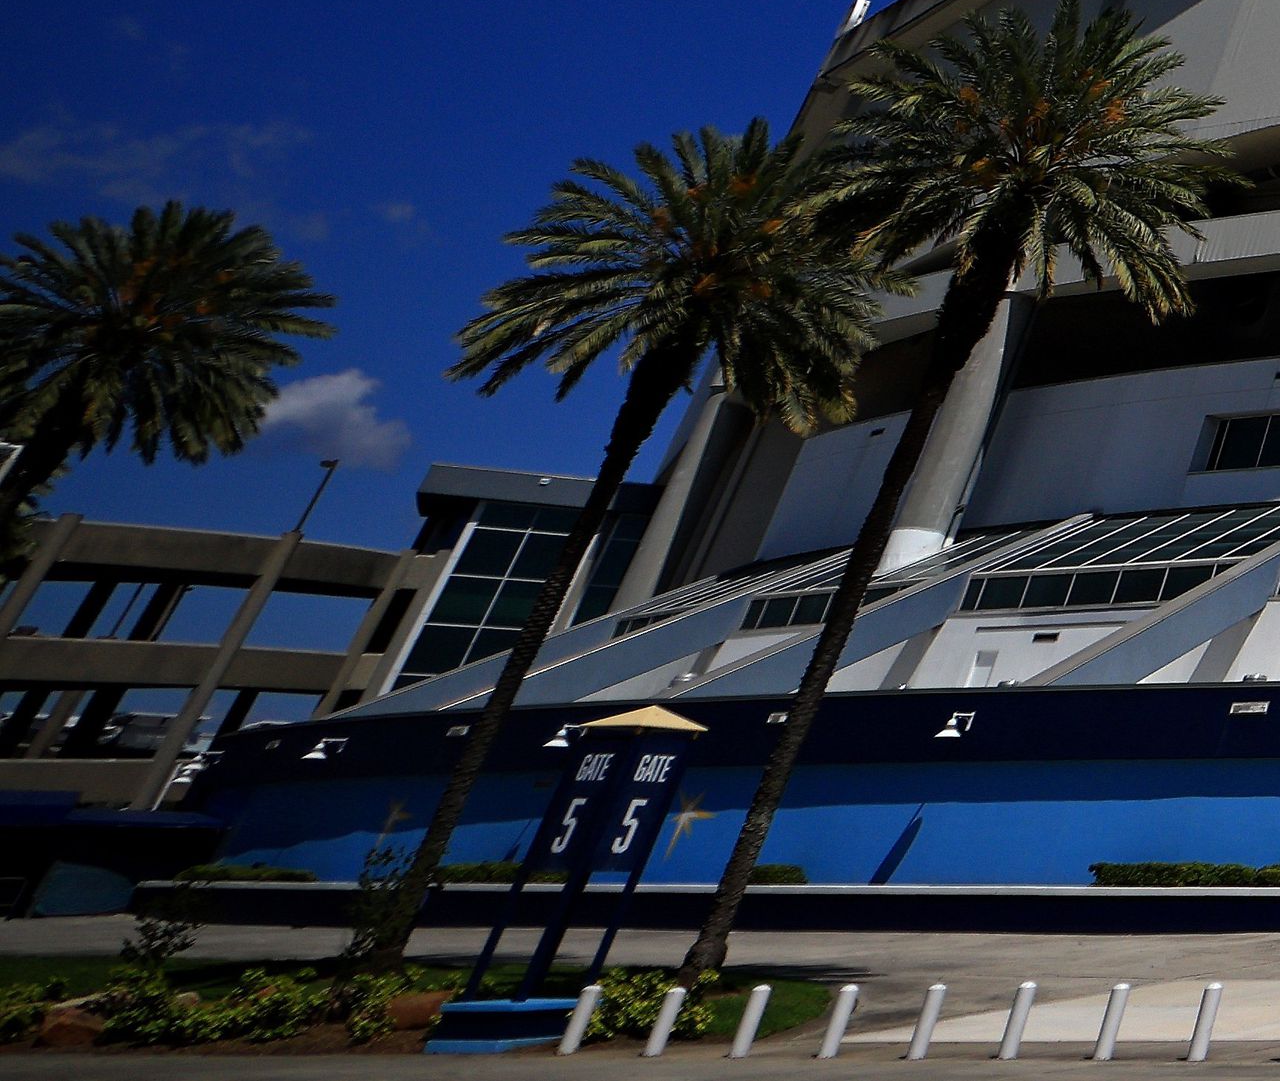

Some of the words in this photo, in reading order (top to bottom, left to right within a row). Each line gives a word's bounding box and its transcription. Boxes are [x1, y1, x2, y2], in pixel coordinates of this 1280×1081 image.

[575, 753, 615, 781] GATE
[633, 754, 676, 782] GATE
[550, 797, 588, 854] 5
[611, 798, 649, 854] 5
